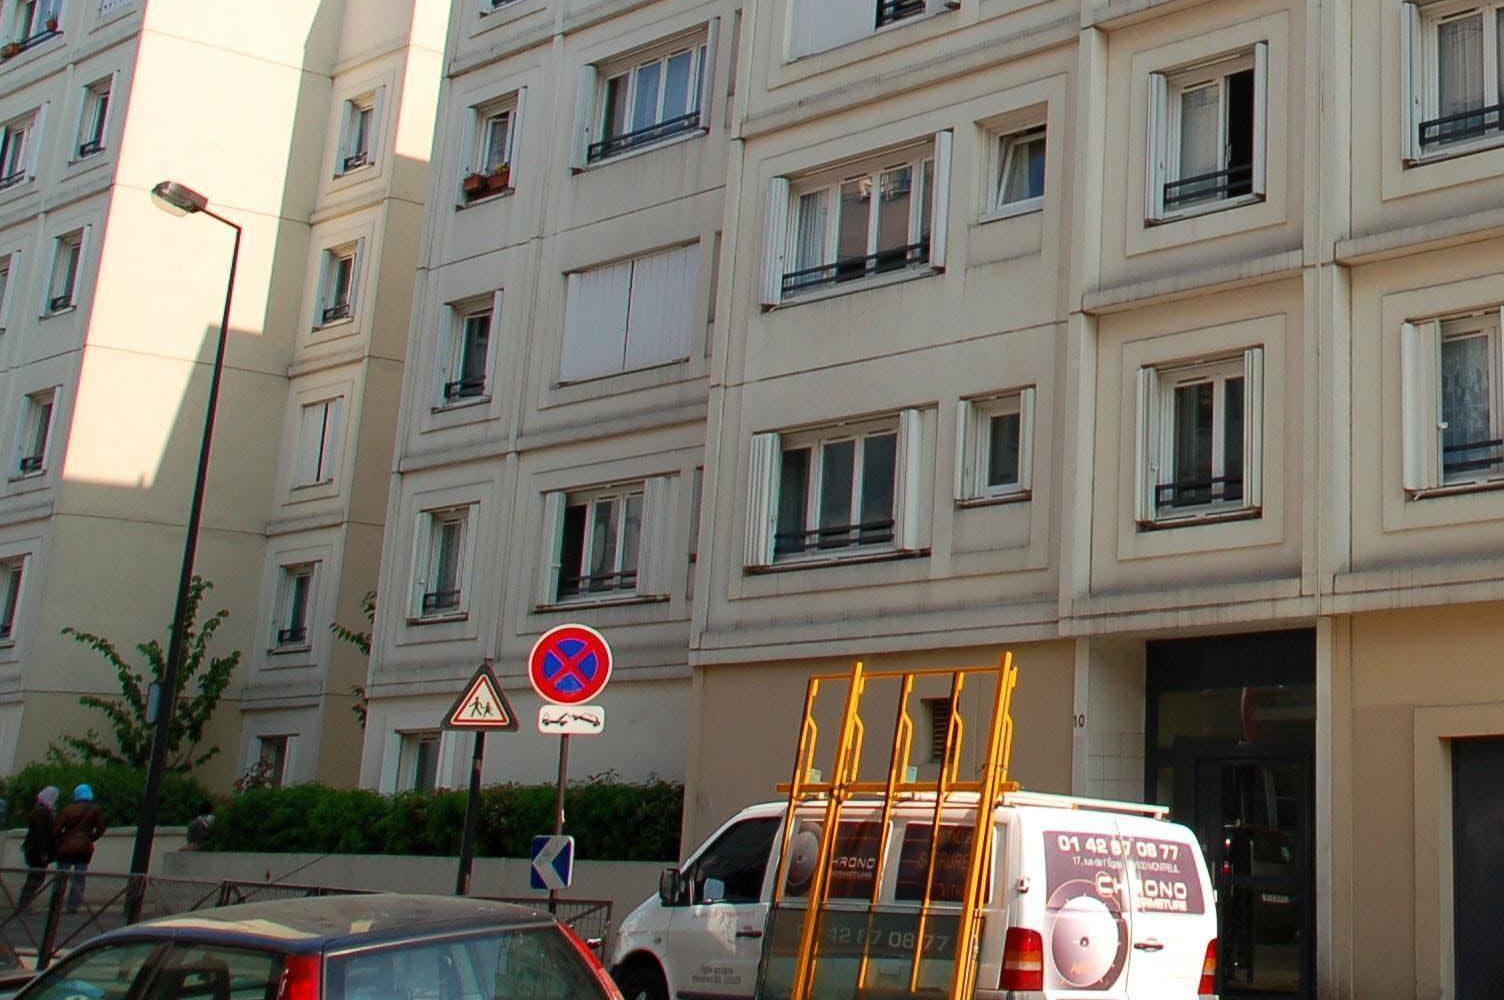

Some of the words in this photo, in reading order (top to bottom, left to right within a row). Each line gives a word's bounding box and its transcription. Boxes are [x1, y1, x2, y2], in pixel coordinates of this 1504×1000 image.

[1073, 714, 1085, 728] 10
[1057, 835, 1080, 852] 01
[1085, 838, 1108, 854] 42
[1136, 841, 1158, 858] 08
[1159, 844, 1179, 860] 77
[1096, 875, 1187, 900] CHONO
[888, 930, 915, 949] 08
[924, 935, 949, 951] 77
